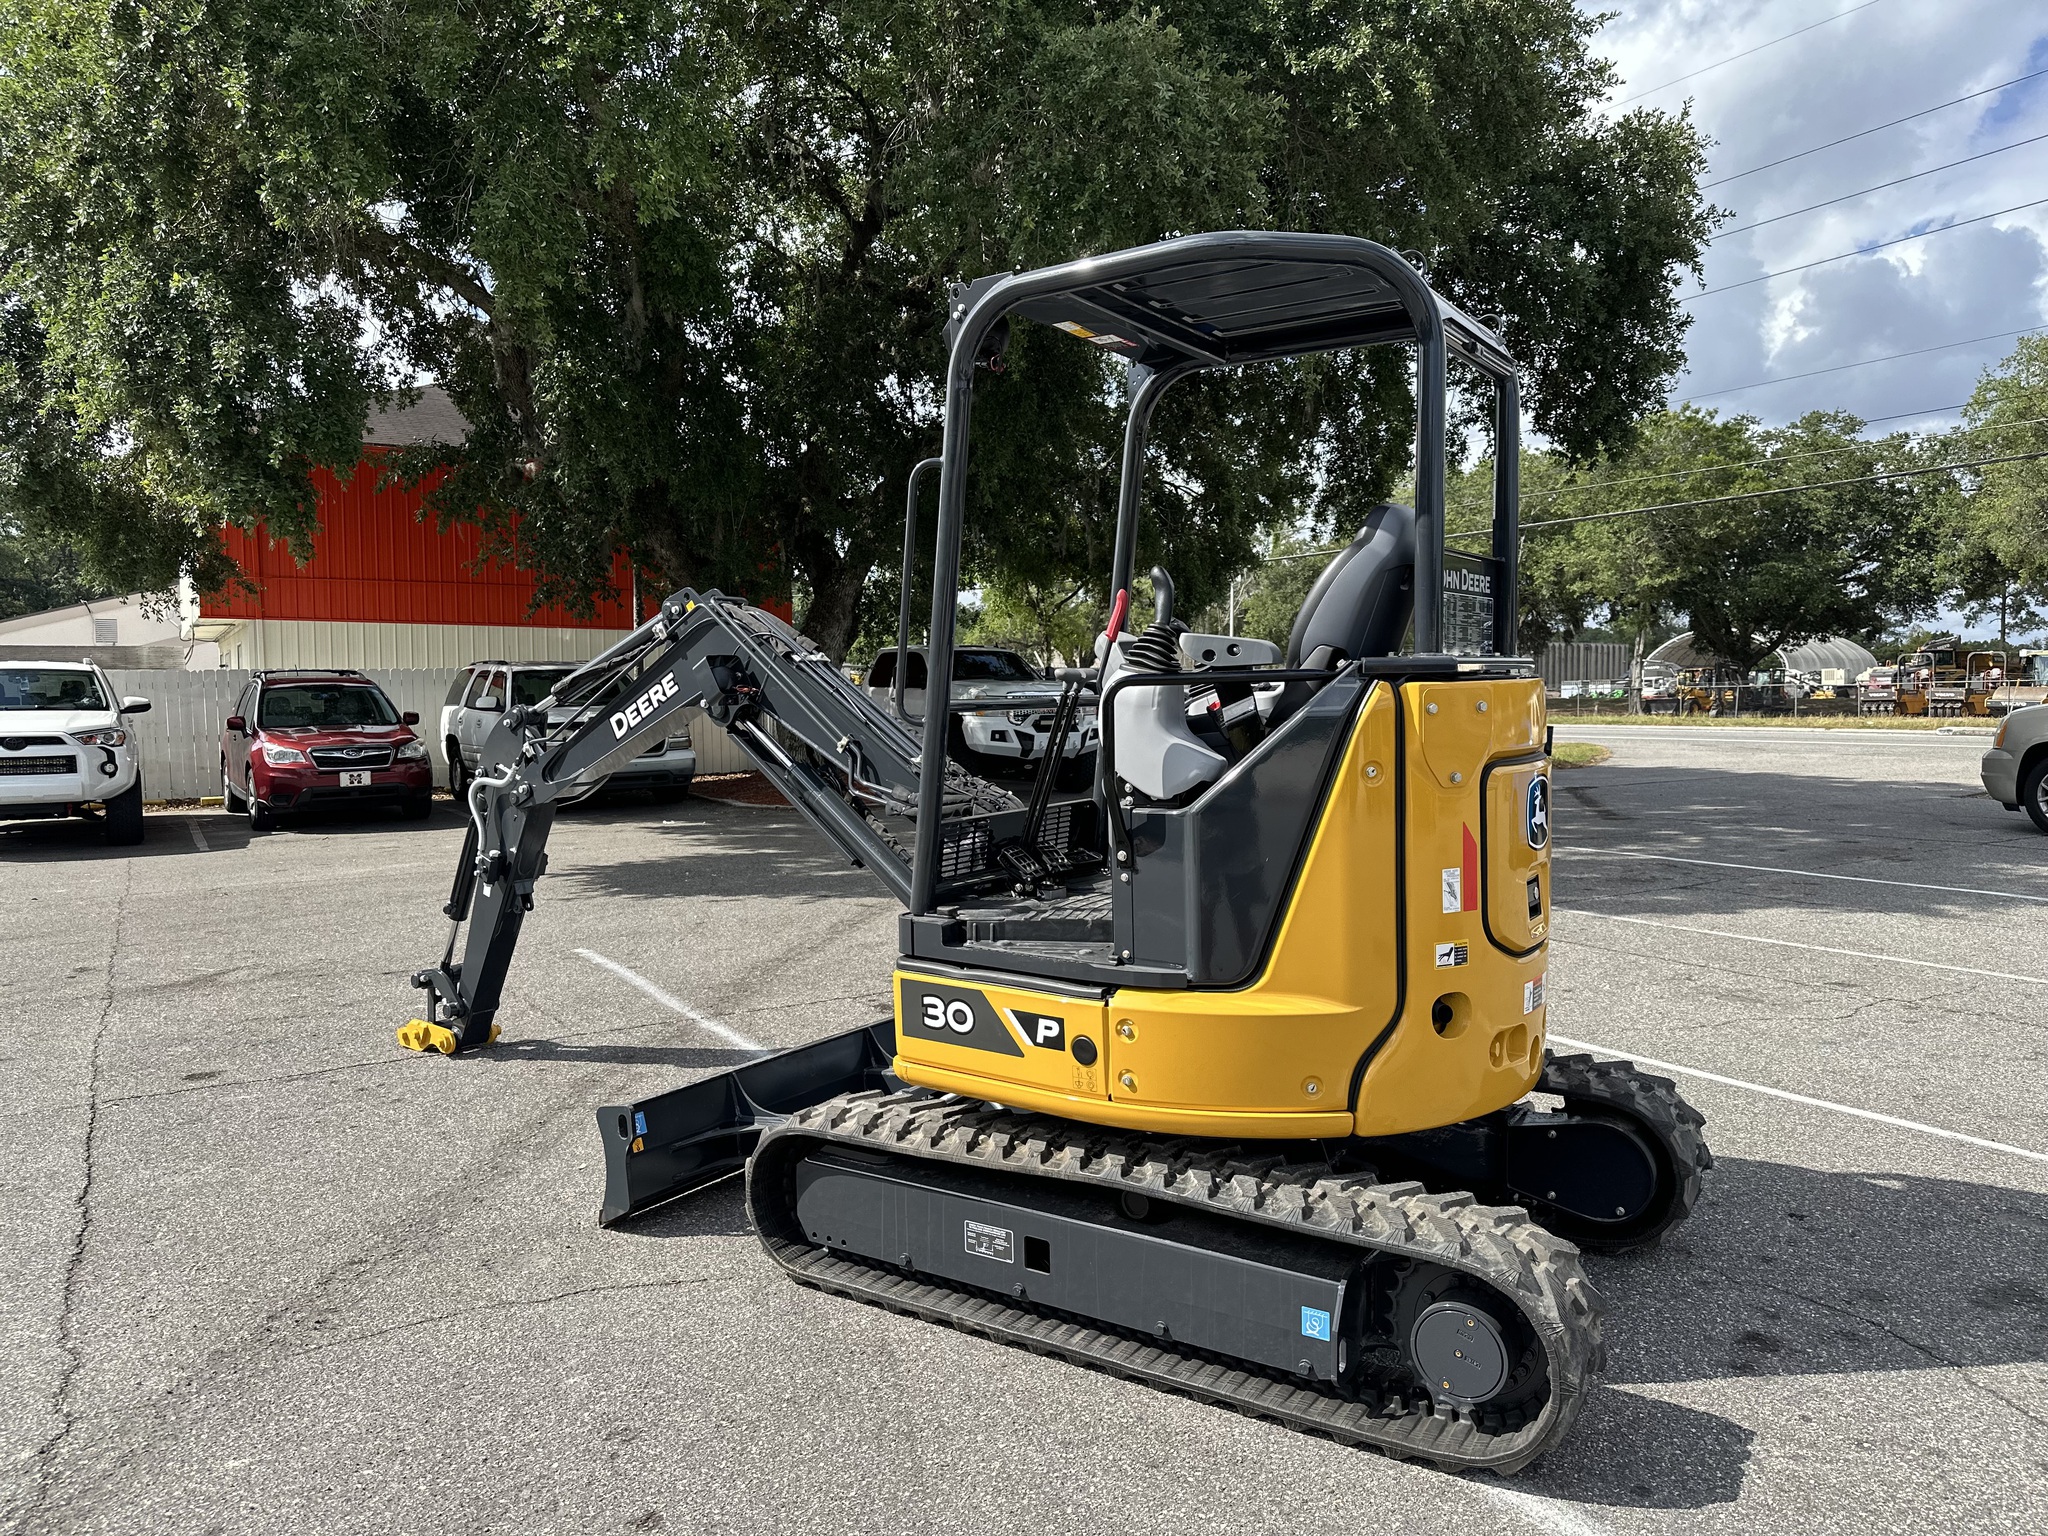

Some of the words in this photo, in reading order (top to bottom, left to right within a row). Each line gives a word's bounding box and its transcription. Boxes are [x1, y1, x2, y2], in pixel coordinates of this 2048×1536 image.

[1443, 569, 1460, 590] HN
[1462, 568, 1491, 594] DEERE
[609, 671, 680, 740] DEERE
[922, 996, 975, 1035] 30
[1036, 1018, 1060, 1044] P
